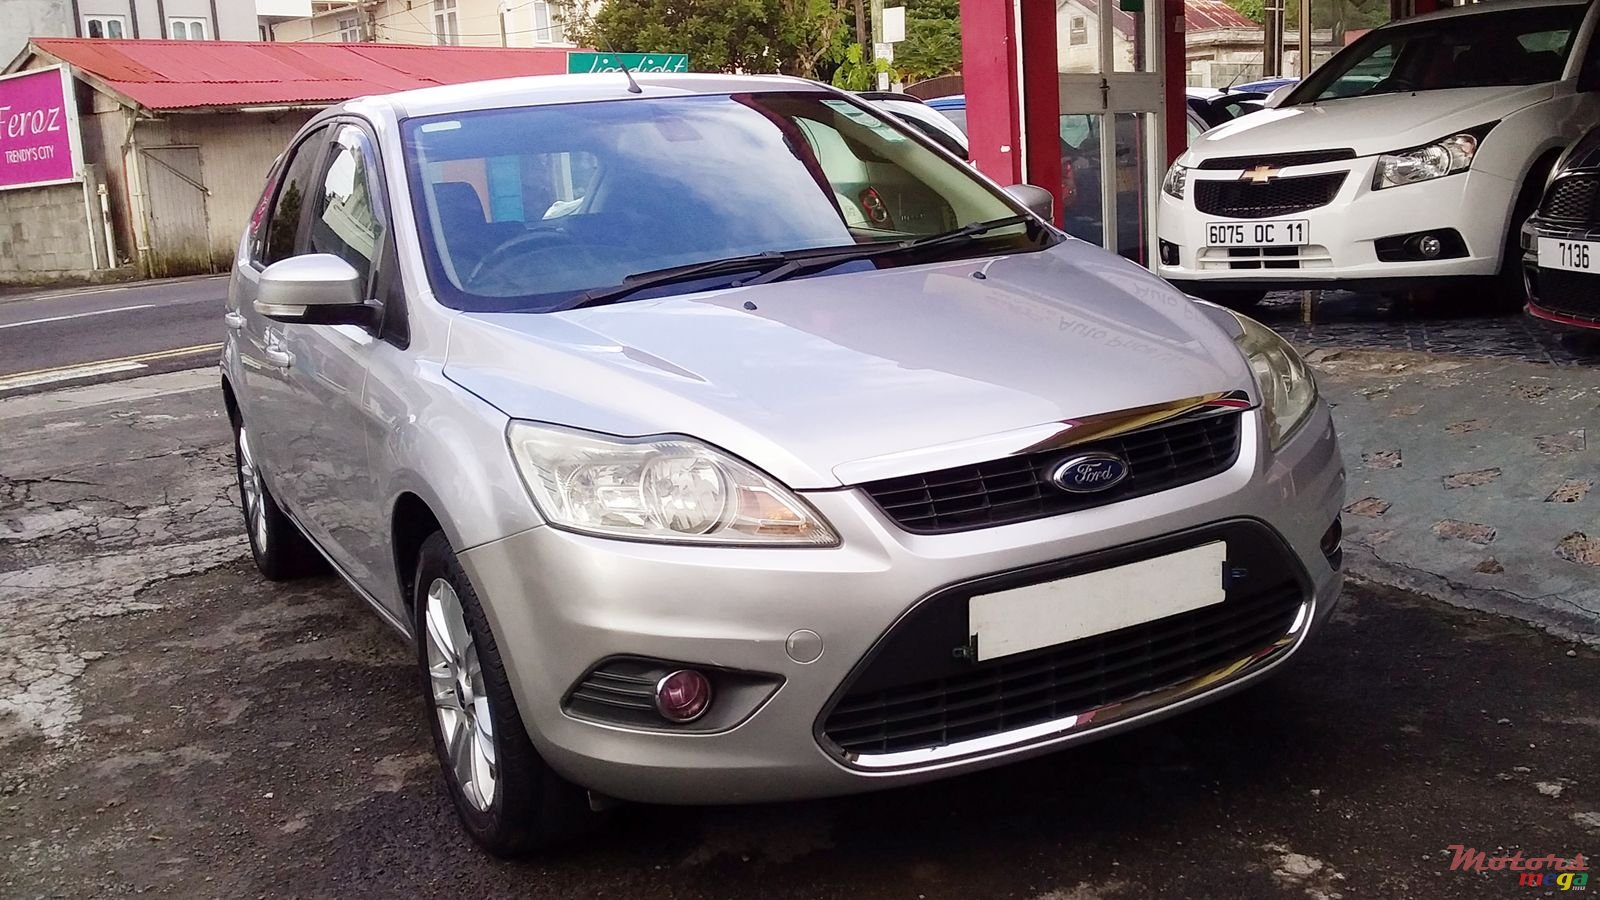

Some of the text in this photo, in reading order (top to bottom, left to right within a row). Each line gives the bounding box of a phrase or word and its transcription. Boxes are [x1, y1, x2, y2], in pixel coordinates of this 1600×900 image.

[5, 145, 55, 164] TRENDY'S CITY
[1210, 223, 1303, 243] 6075 OC 11
[1559, 243, 1590, 269] 7136
[1074, 462, 1113, 484] Ford
